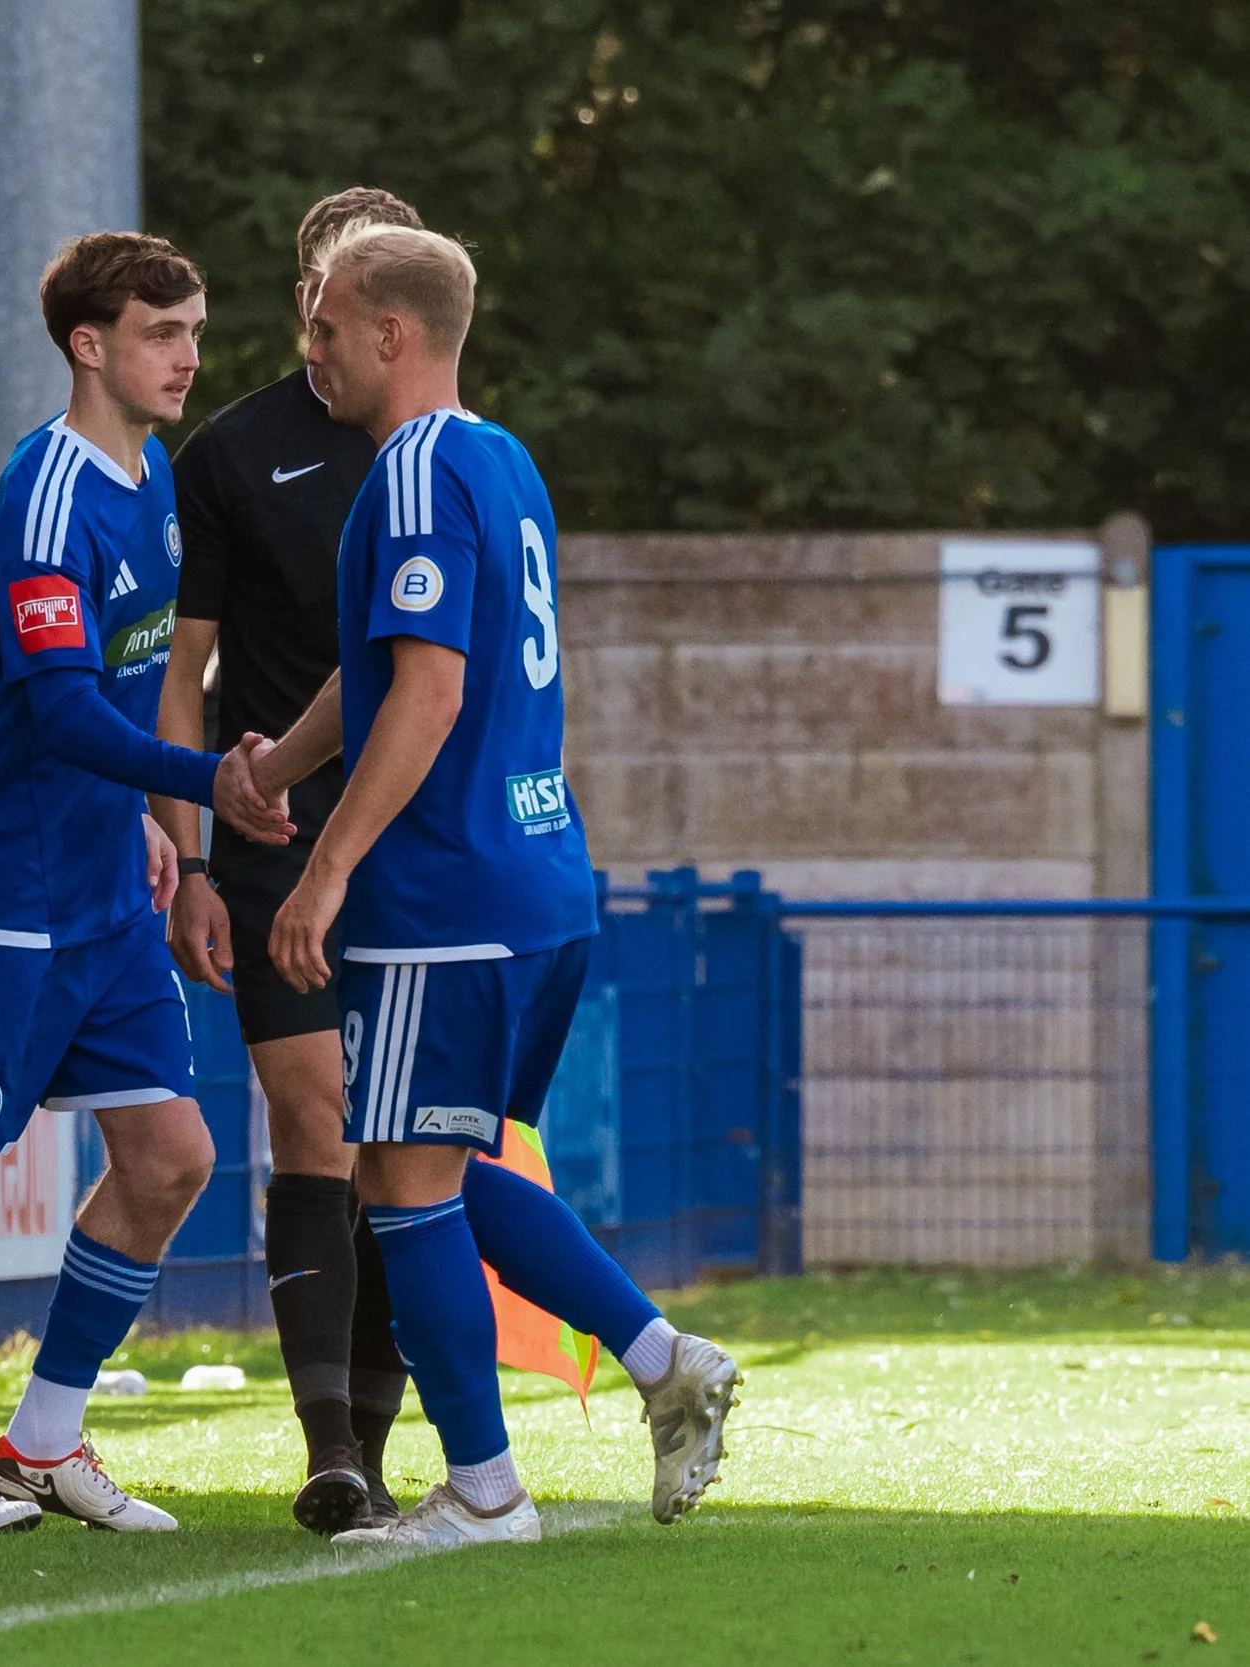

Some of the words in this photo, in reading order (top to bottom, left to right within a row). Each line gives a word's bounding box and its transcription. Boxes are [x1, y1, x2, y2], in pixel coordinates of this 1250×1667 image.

[403, 573, 428, 595] B
[24, 599, 68, 617] PITCHING
[519, 517, 558, 690] 9
[45, 610, 56, 624] IN
[1000, 605, 1051, 671] 5
[116, 659, 151, 678] Electr
[451, 1115, 480, 1125] AZTEK
